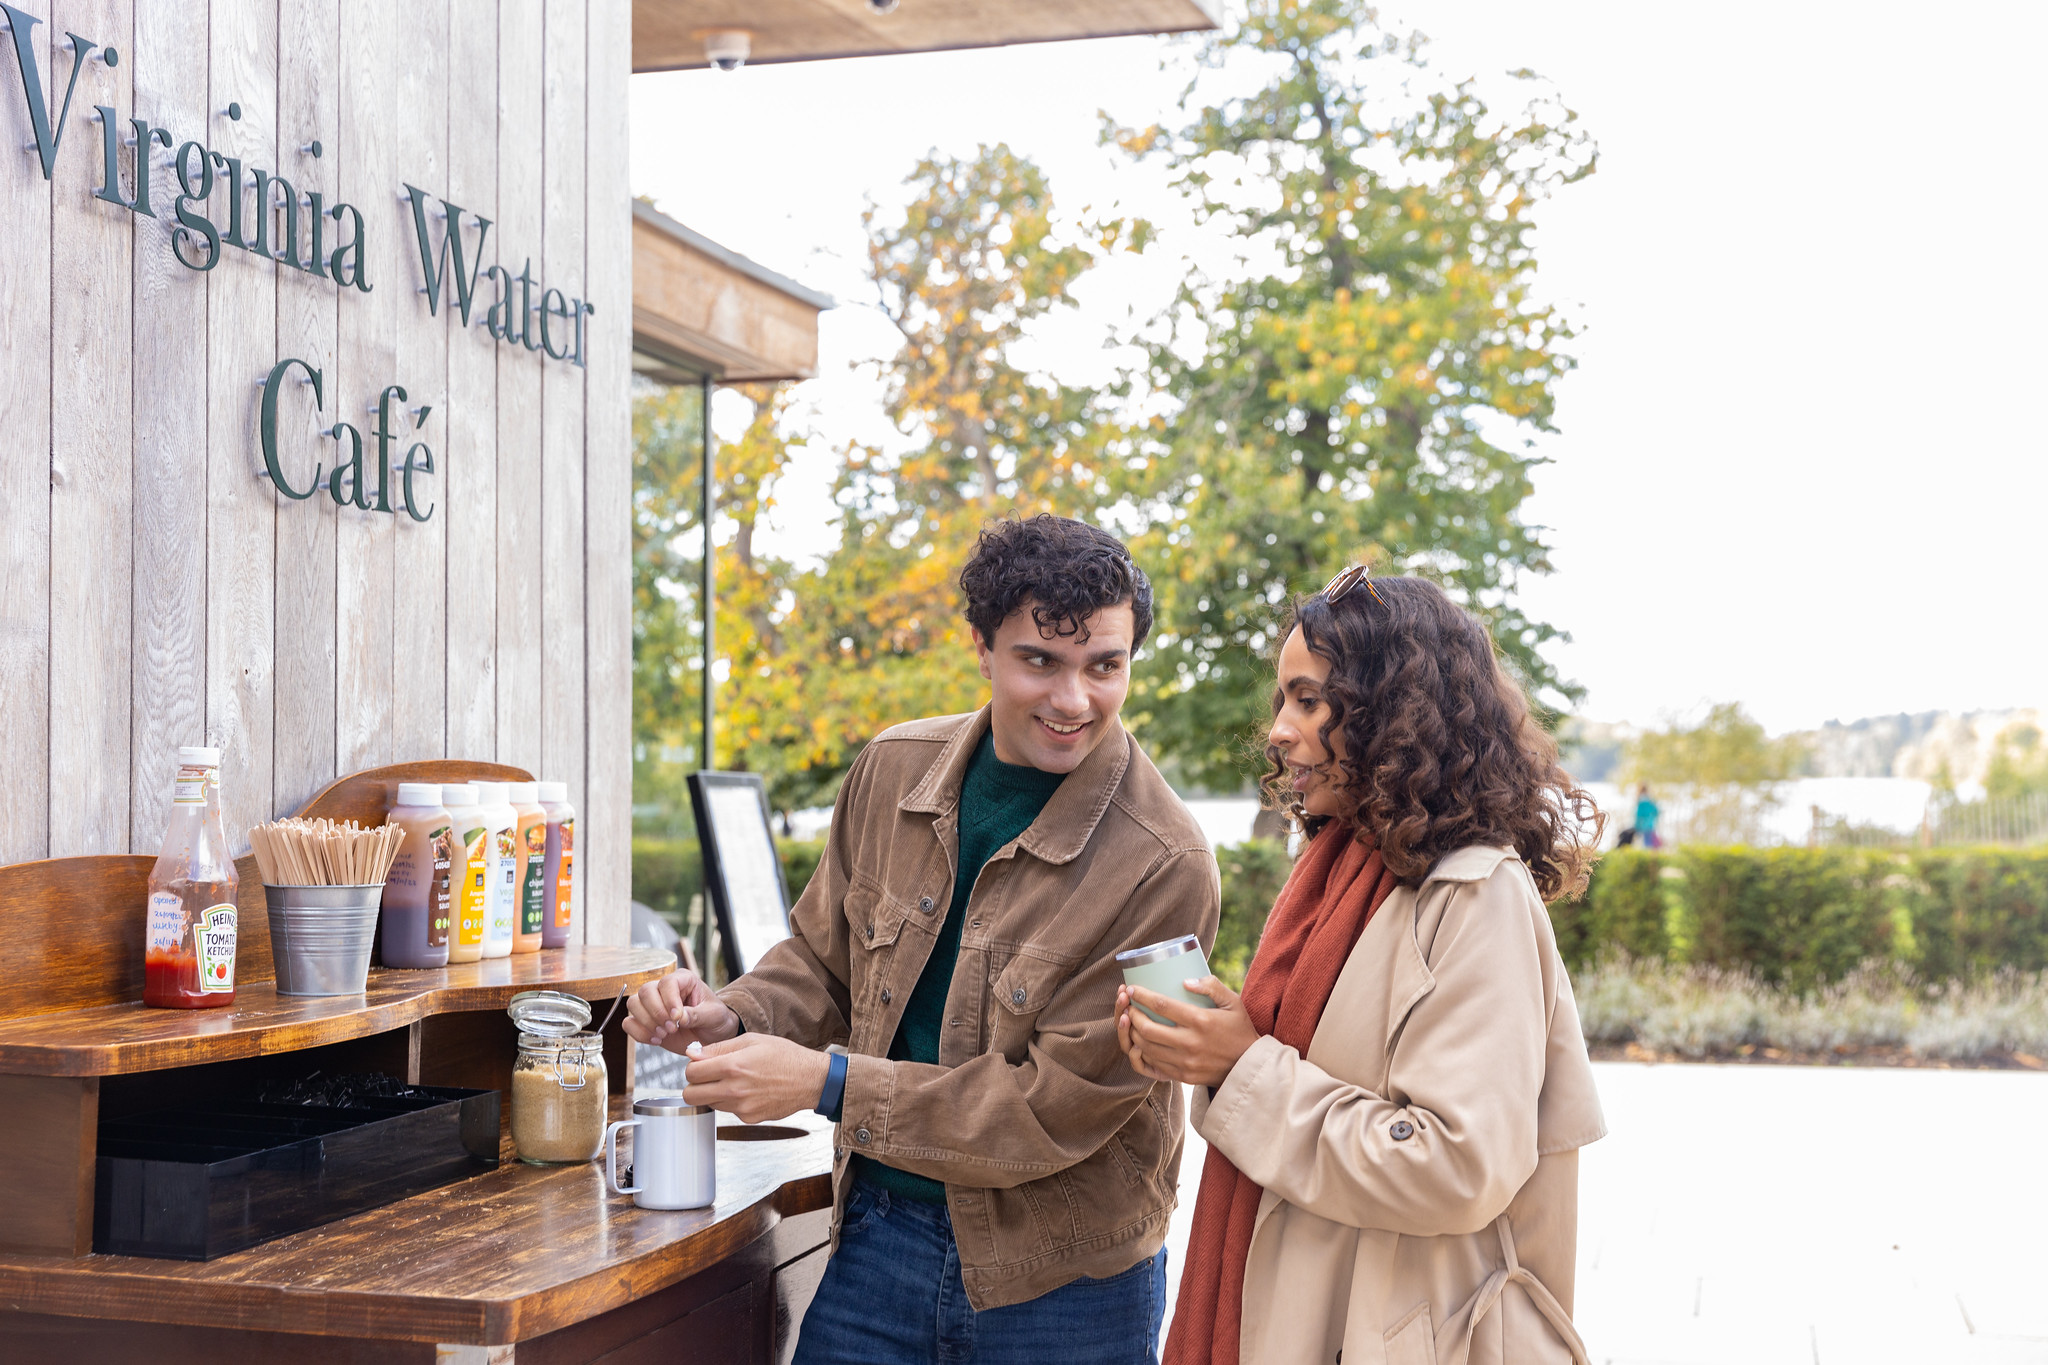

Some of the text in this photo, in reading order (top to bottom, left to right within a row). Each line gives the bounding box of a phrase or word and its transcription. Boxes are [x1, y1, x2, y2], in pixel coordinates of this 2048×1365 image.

[0, 2, 595, 369] Virginia Water
[260, 358, 435, 522] Café
[212, 912, 236, 927] HEINZ
[206, 933, 236, 945] TOMATO
[206, 946, 234, 956] KETCHUP
